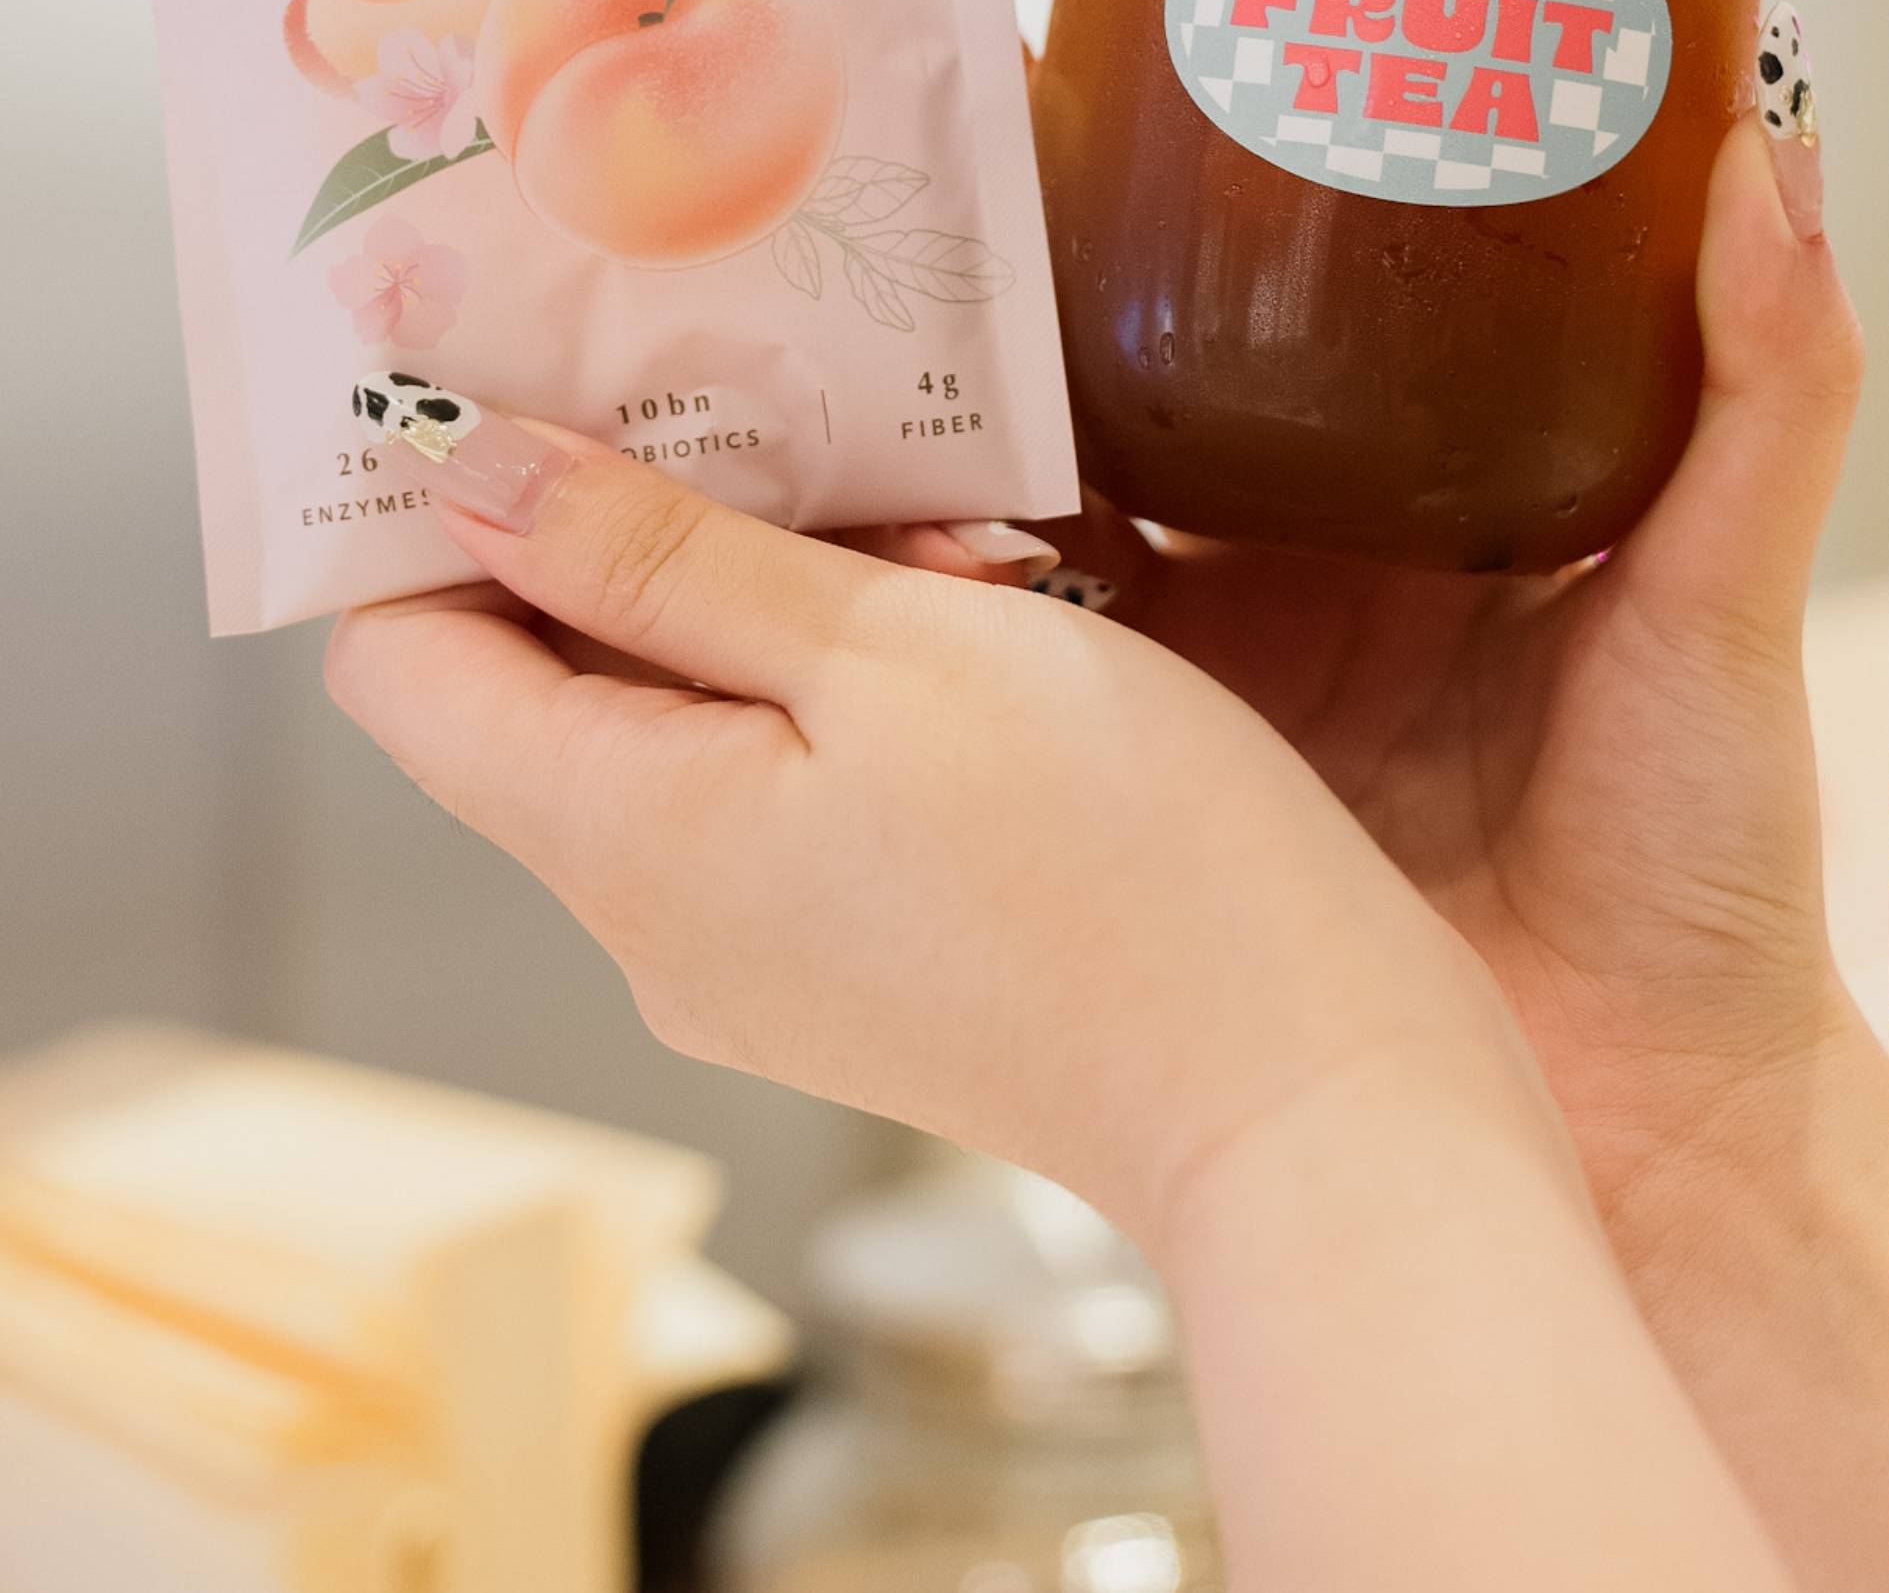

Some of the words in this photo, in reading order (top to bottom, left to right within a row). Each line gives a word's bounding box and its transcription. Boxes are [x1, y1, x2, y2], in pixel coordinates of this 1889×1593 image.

[1283, 42, 1540, 143] TEA
[616, 392, 711, 425] 10bn
[900, 411, 984, 441] FIBER
[337, 448, 379, 477] 26
[621, 429, 760, 463] BIOTICS
